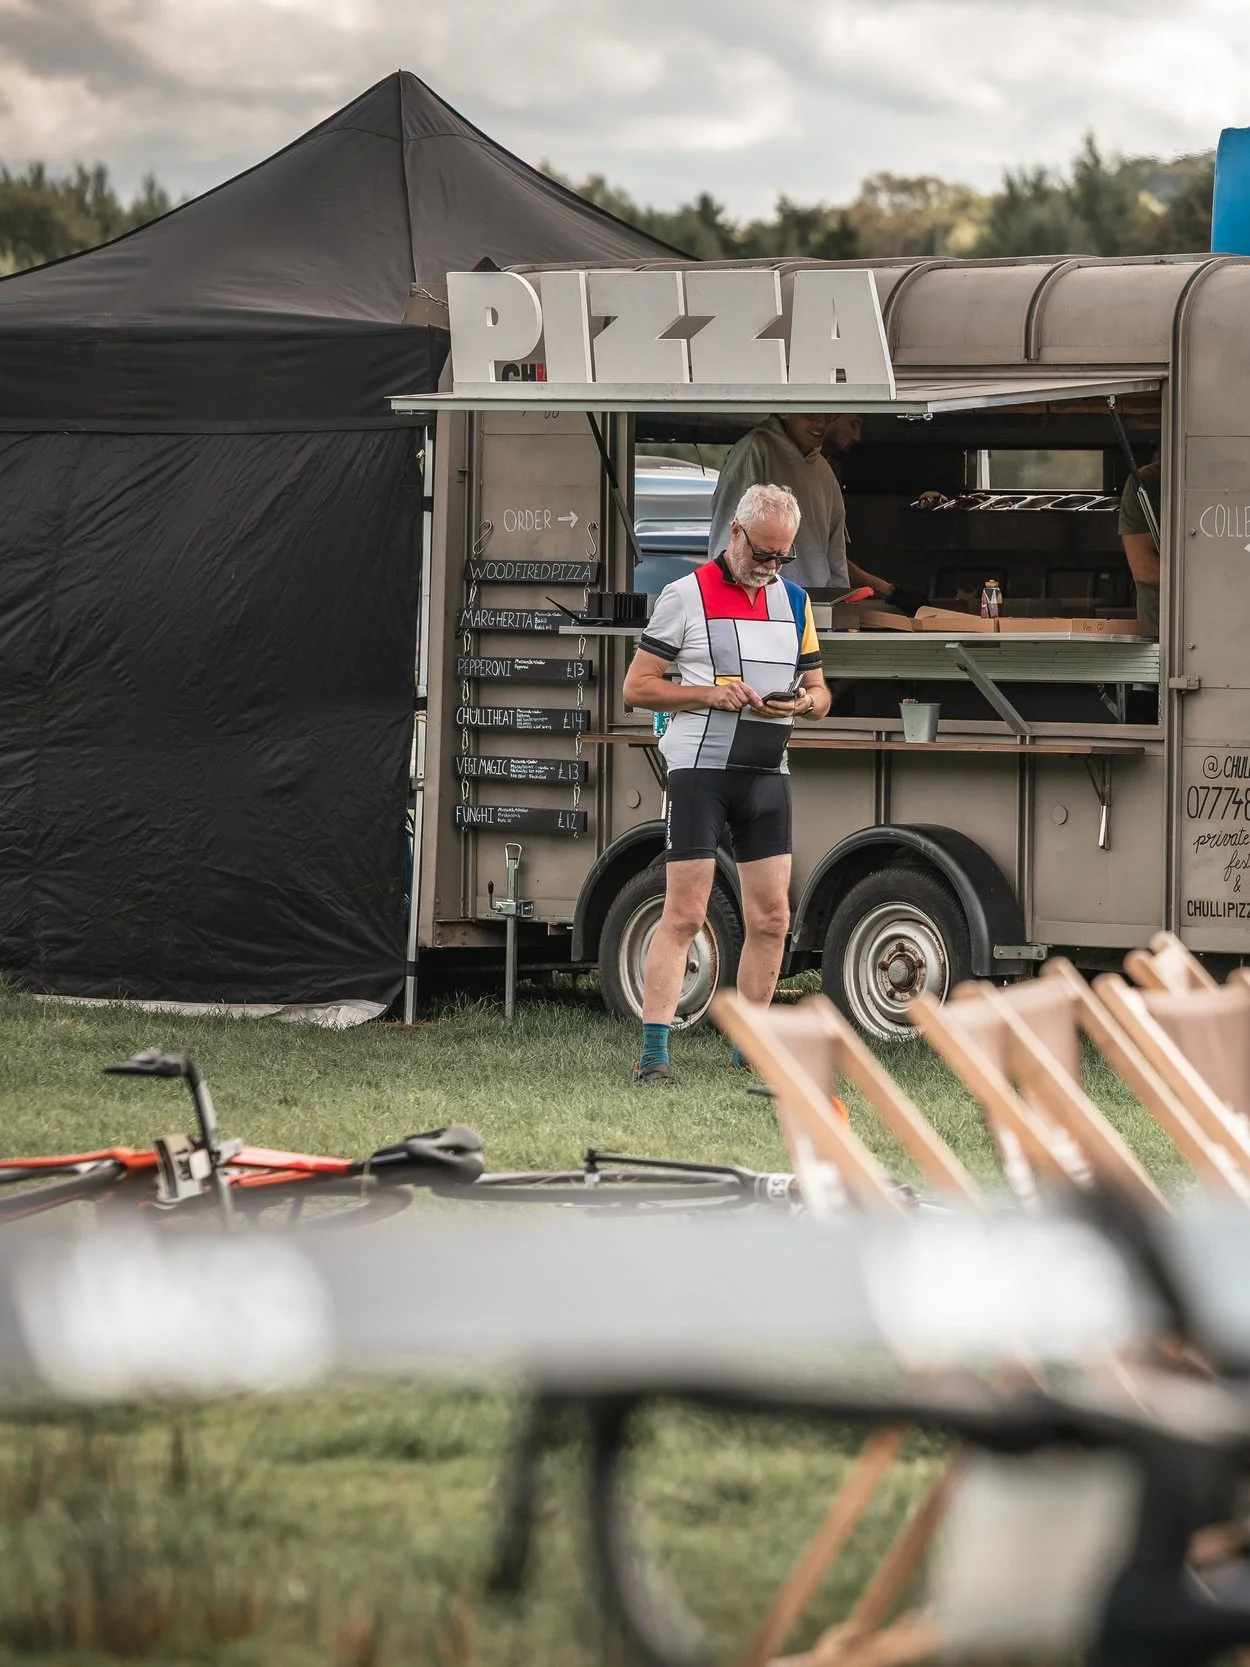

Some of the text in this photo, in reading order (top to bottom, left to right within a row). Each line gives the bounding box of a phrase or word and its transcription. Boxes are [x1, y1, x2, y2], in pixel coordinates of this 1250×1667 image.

[446, 269, 897, 393] PIZZA
[503, 509, 552, 533] ORDER
[460, 609, 533, 628] MARGHERITA
[457, 658, 585, 679] PEPPERONI £13
[563, 711, 584, 730] £14
[558, 762, 580, 780] £13
[456, 805, 495, 824] FUNGHI
[558, 811, 577, 830] £12
[1193, 827, 1250, 853] private
[1233, 875, 1241, 893] &
